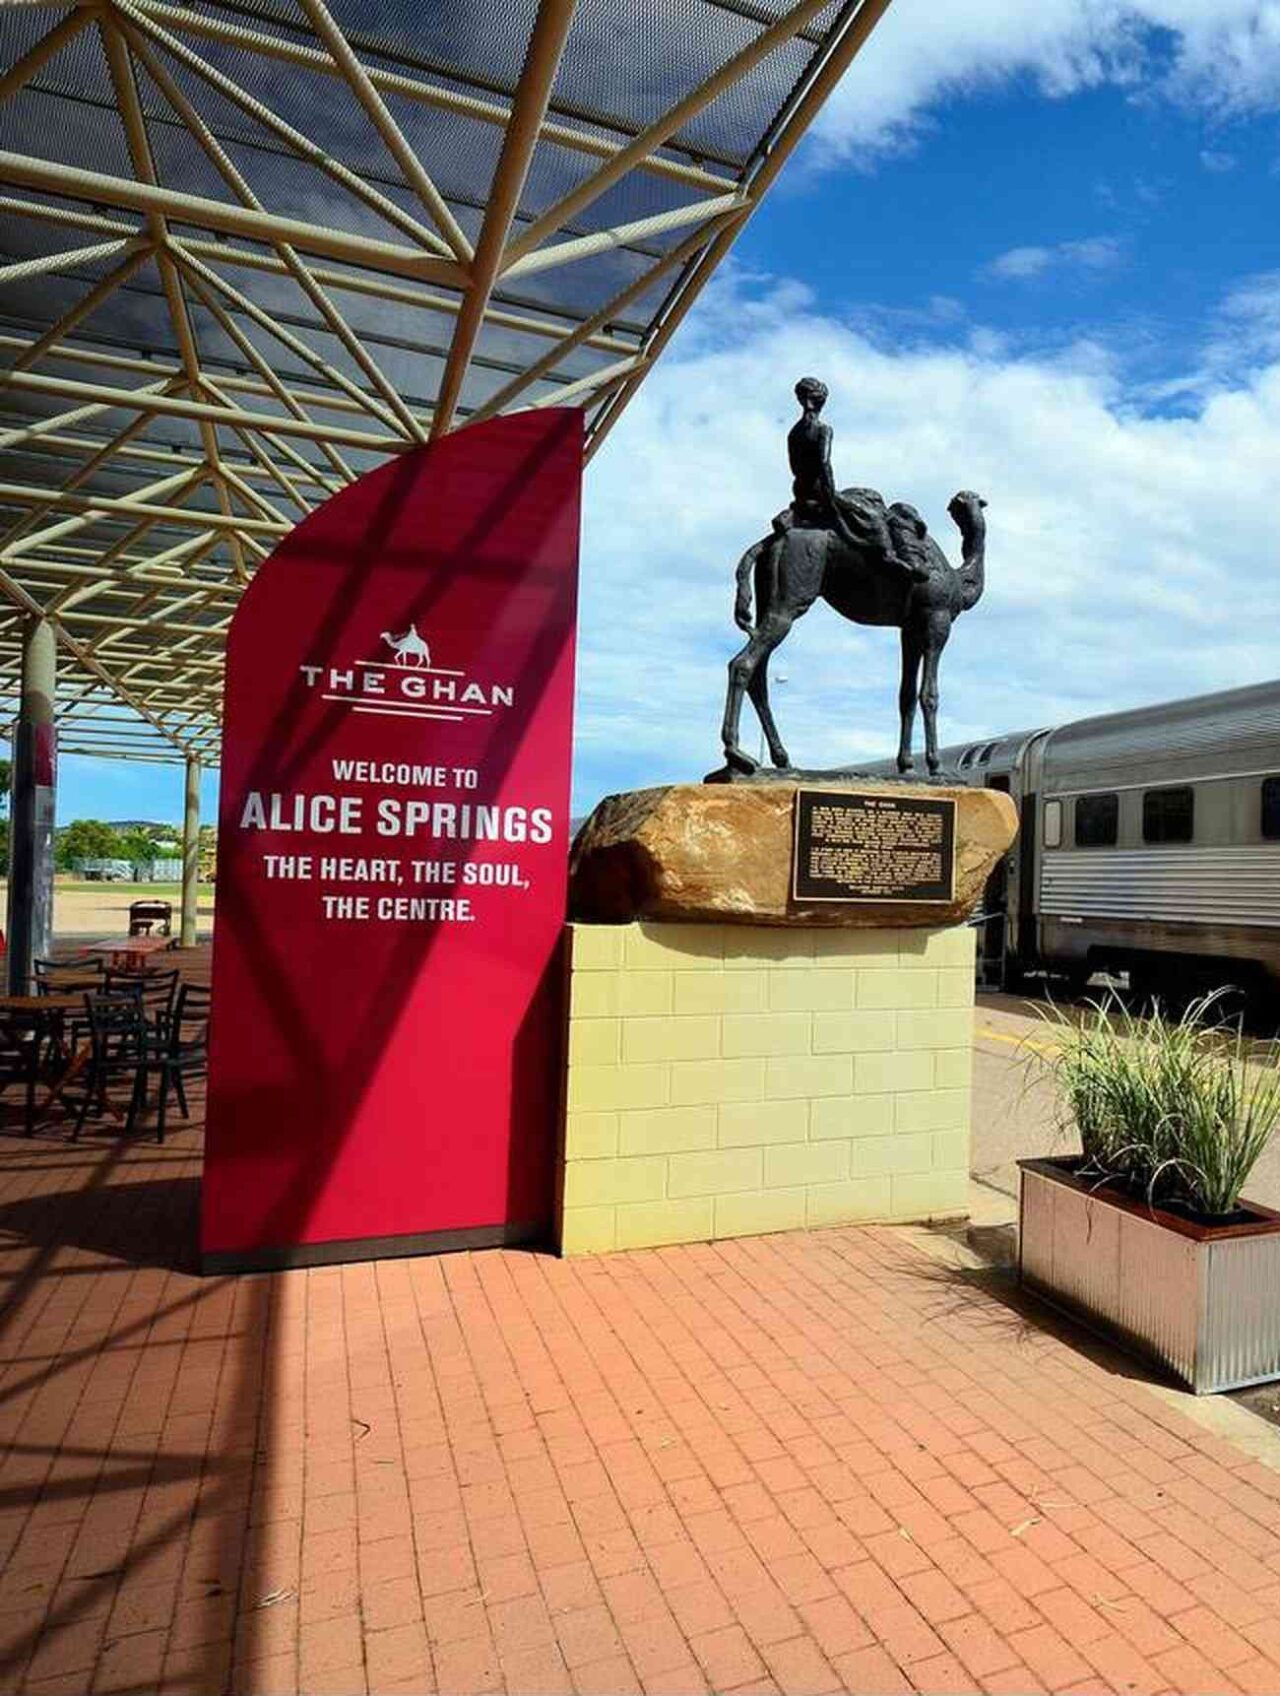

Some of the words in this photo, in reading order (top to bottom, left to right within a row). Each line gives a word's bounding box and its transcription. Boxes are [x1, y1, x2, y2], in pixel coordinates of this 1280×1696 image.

[300, 666, 386, 694] THE
[400, 677, 514, 706] GHAN
[332, 759, 446, 788] WELCOME
[452, 767, 479, 789] TO
[240, 791, 362, 834] ALICE
[377, 799, 553, 843] SPRINGS
[263, 855, 312, 879] THE
[320, 857, 404, 885] HEART,
[411, 861, 456, 884] THE
[463, 862, 530, 889] SOUL,
[322, 896, 369, 920] THE
[377, 897, 476, 922] CENTRE.
